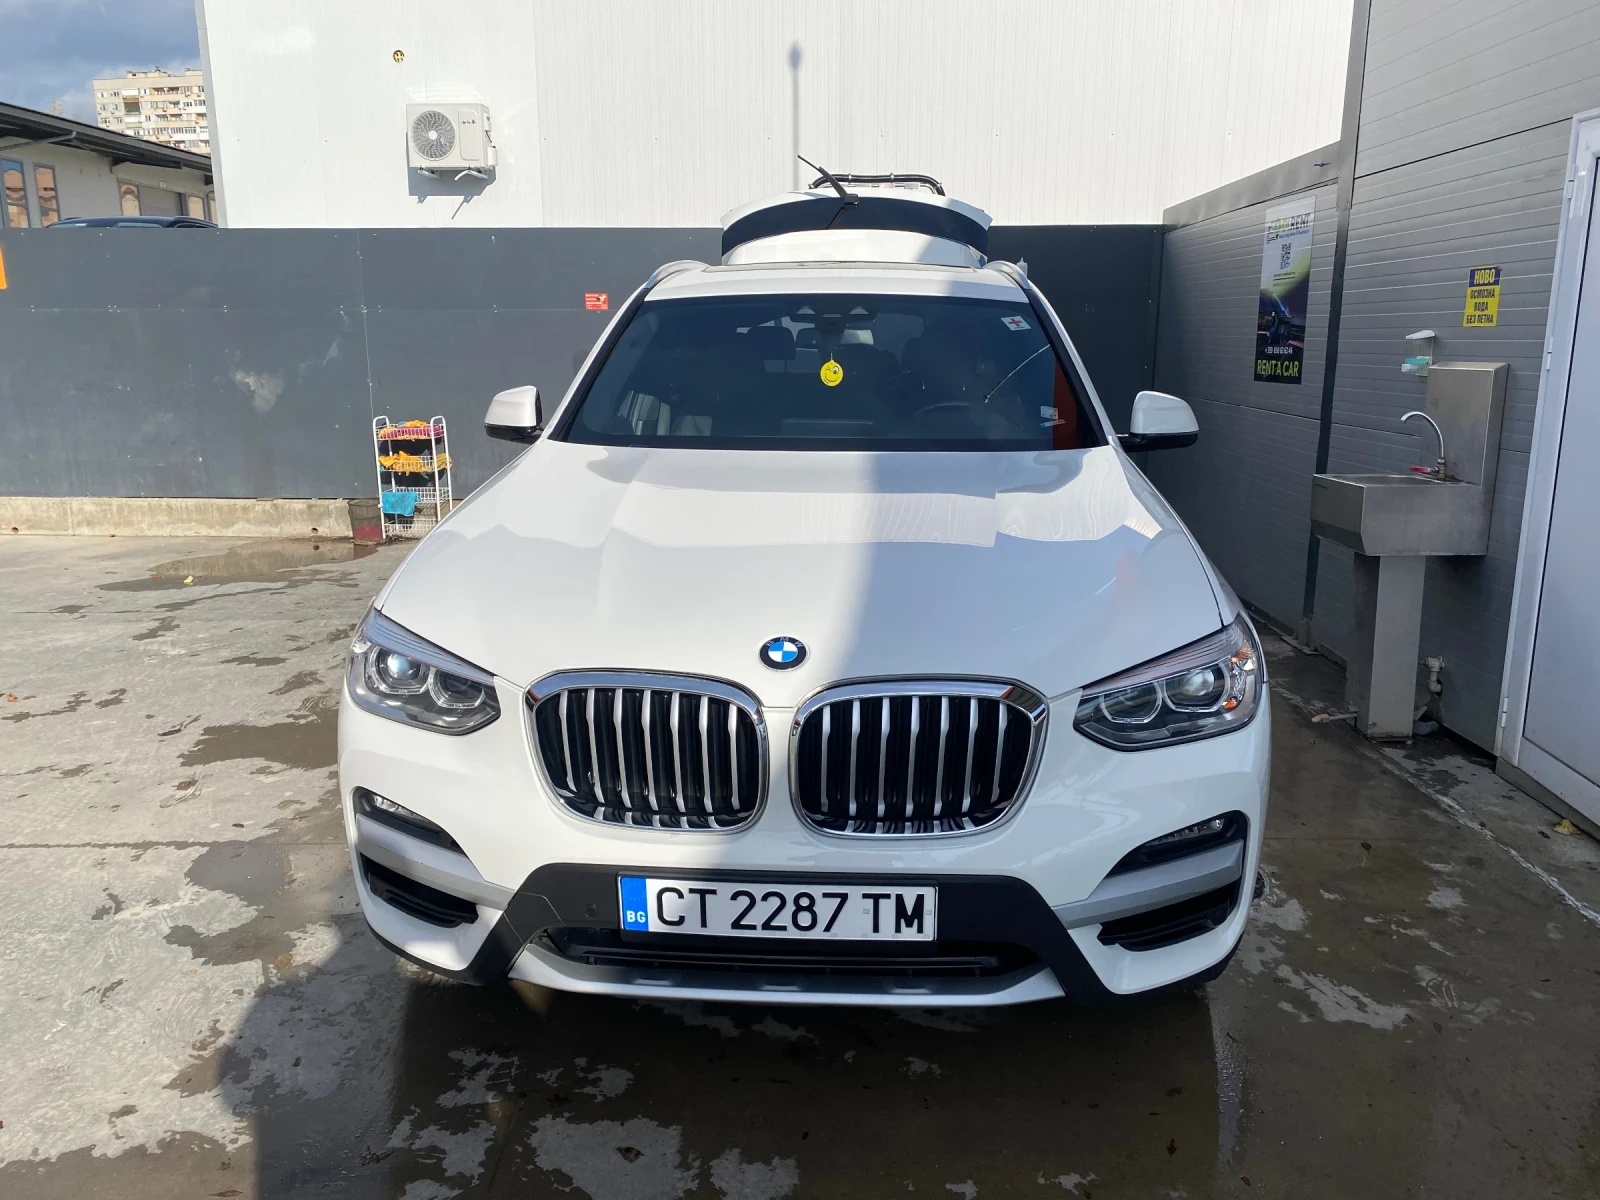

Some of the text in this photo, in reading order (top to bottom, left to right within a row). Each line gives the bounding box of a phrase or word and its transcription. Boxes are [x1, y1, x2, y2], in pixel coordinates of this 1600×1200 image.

[1474, 269, 1495, 284] НОВО
[1474, 302, 1488, 312] ВОДА
[1466, 314, 1494, 324] БЕЗ ПЕТНА
[1257, 360, 1299, 376] RENT A CAR
[765, 637, 804, 648] BMW
[626, 910, 646, 923] BG
[656, 887, 925, 934] CT 2287 TM
